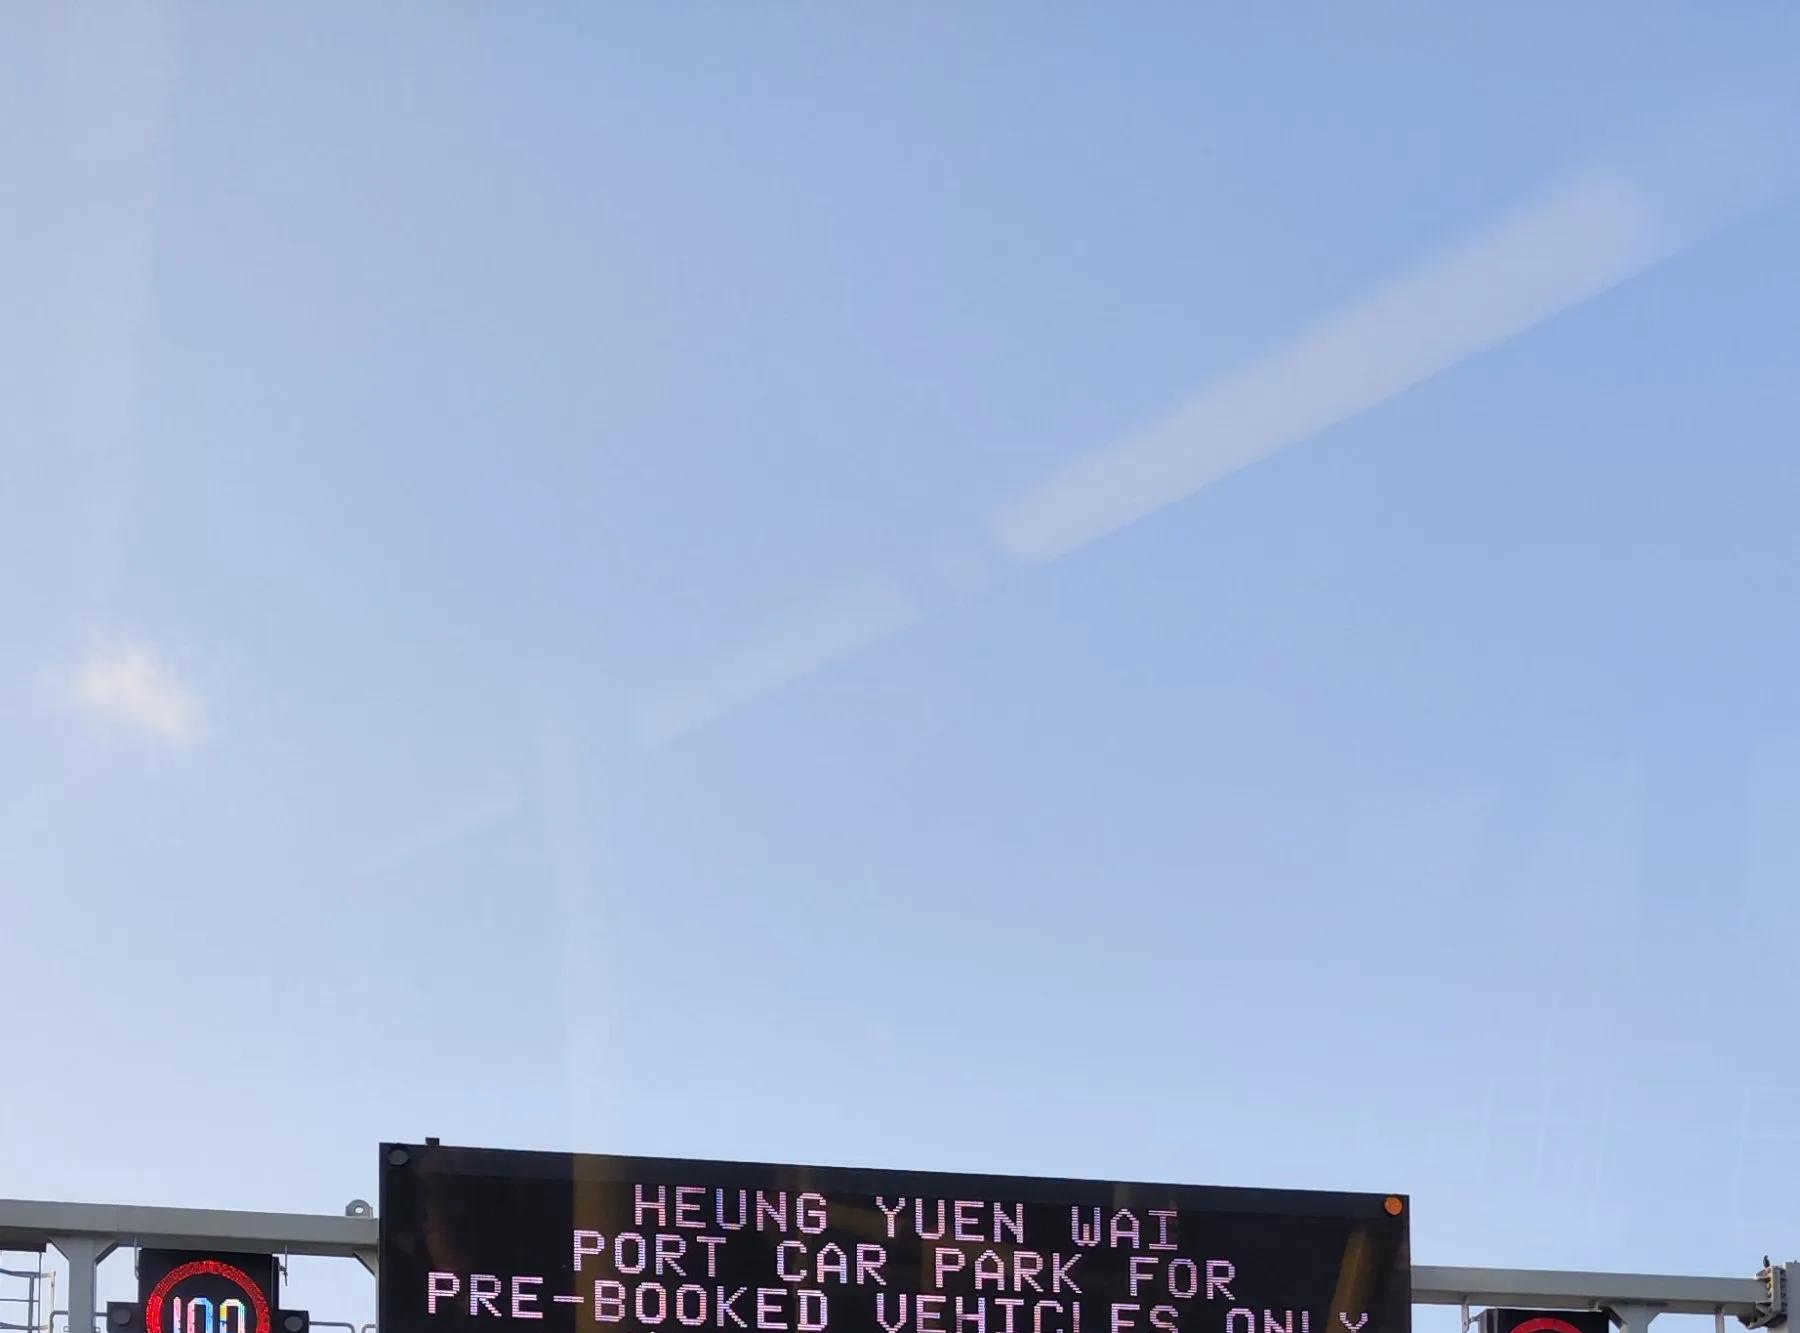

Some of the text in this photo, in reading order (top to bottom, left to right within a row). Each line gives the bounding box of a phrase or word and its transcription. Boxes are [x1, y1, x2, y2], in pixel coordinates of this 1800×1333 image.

[633, 1184, 1178, 1251] HEUNG YUEN WAI
[573, 1230, 1236, 1300] PORT CAR PARK FOR
[427, 1272, 829, 1331] PRE-BOOKED
